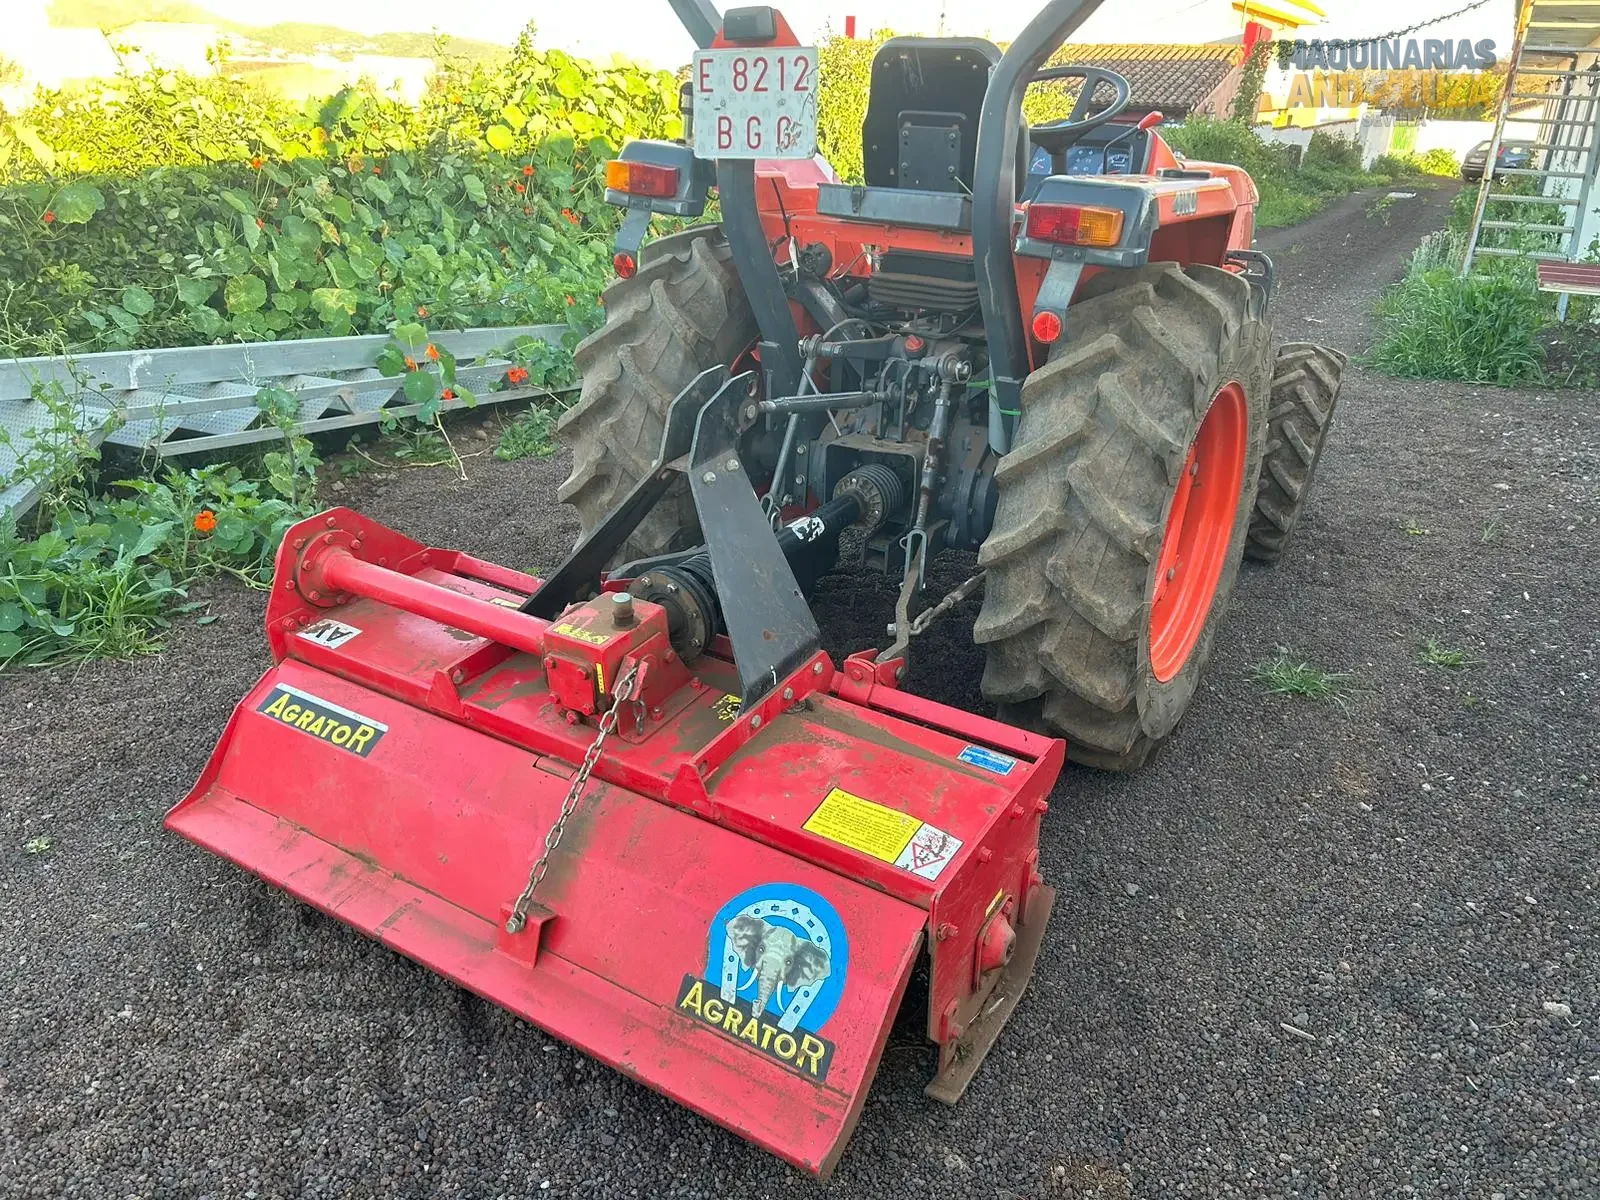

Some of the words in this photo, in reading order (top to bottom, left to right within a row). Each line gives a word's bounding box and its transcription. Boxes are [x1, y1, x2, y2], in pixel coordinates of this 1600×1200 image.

[700, 58, 714, 92] E
[732, 55, 809, 92] 8212
[264, 692, 375, 753] AGRATOR
[680, 981, 825, 1075] AGRATOR
